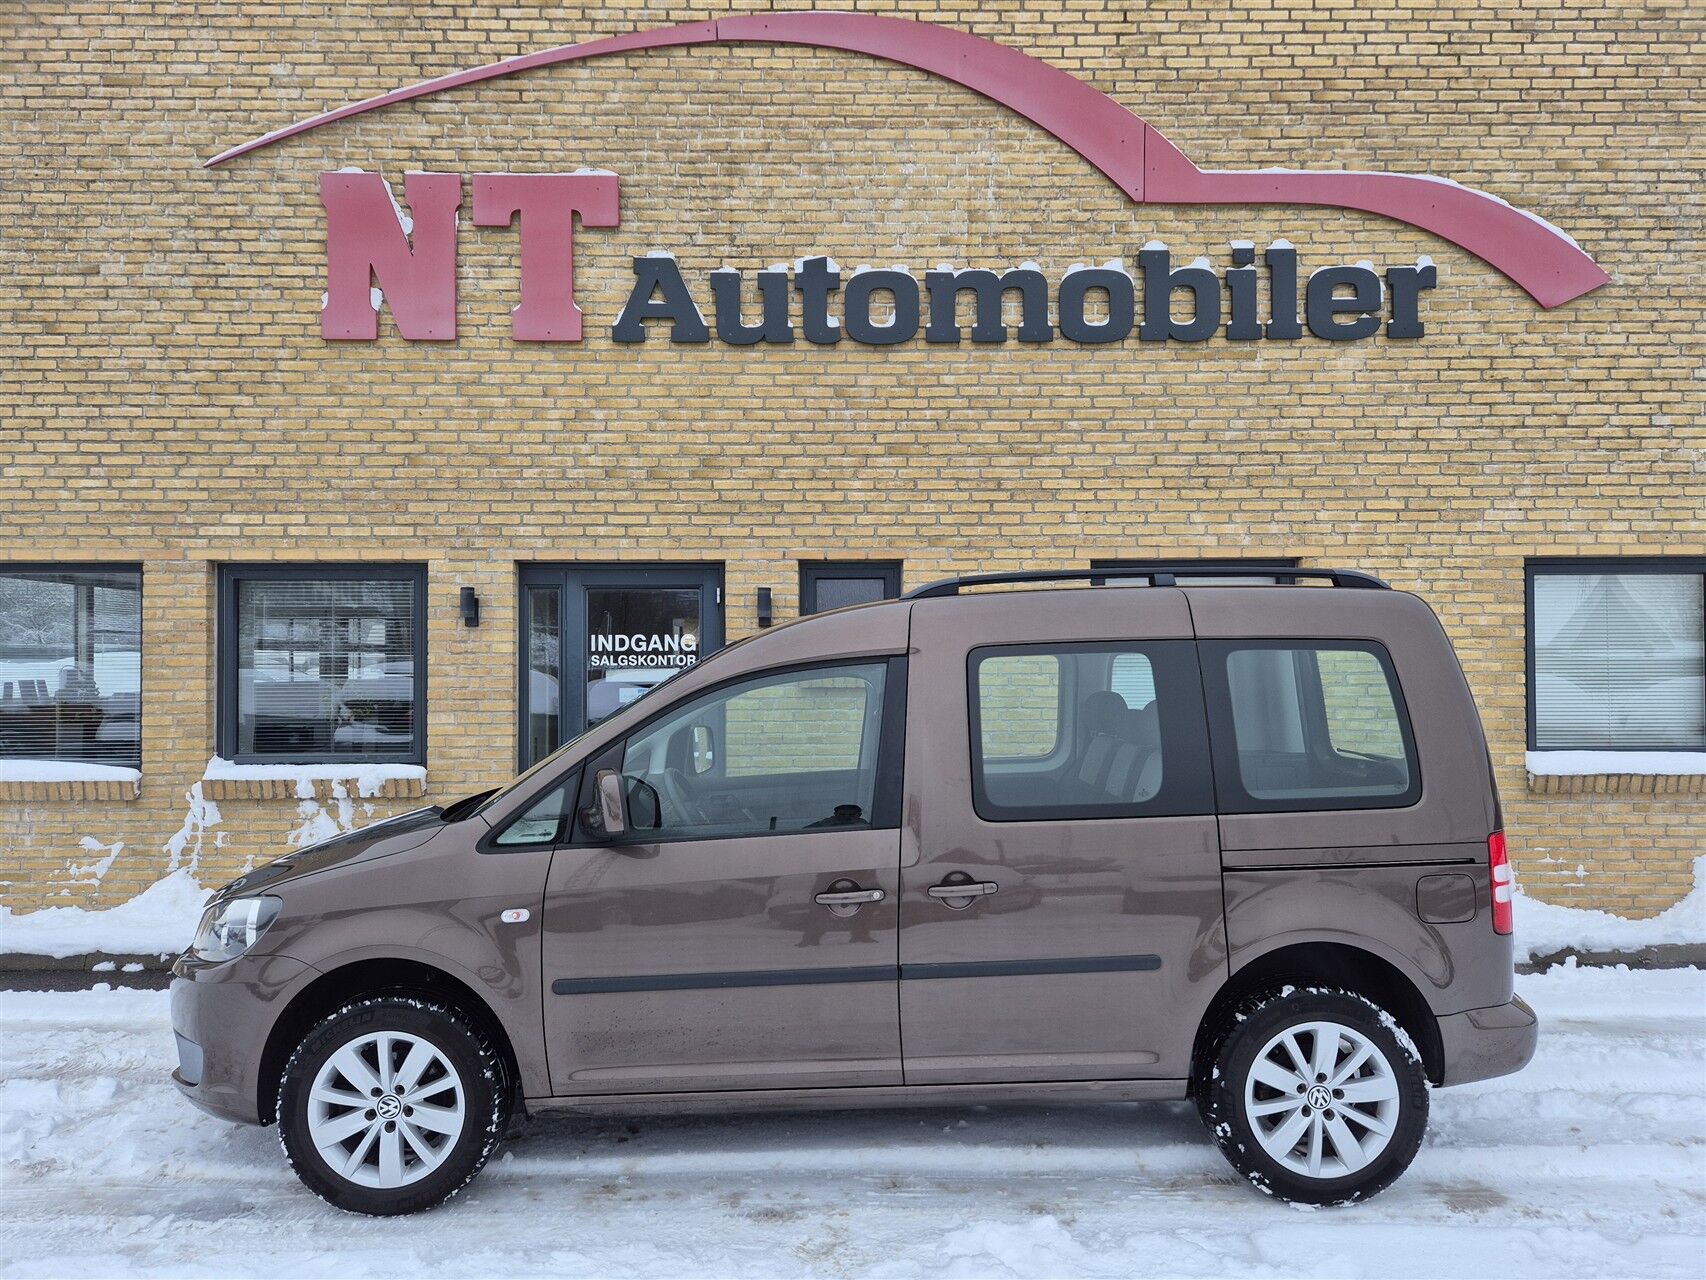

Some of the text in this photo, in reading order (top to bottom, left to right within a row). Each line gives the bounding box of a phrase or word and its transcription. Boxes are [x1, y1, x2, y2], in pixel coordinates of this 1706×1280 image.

[319, 171, 1438, 346] NT Automobiler
[590, 633, 697, 652] INDGANG
[590, 654, 697, 667] SALGSKONTOR
